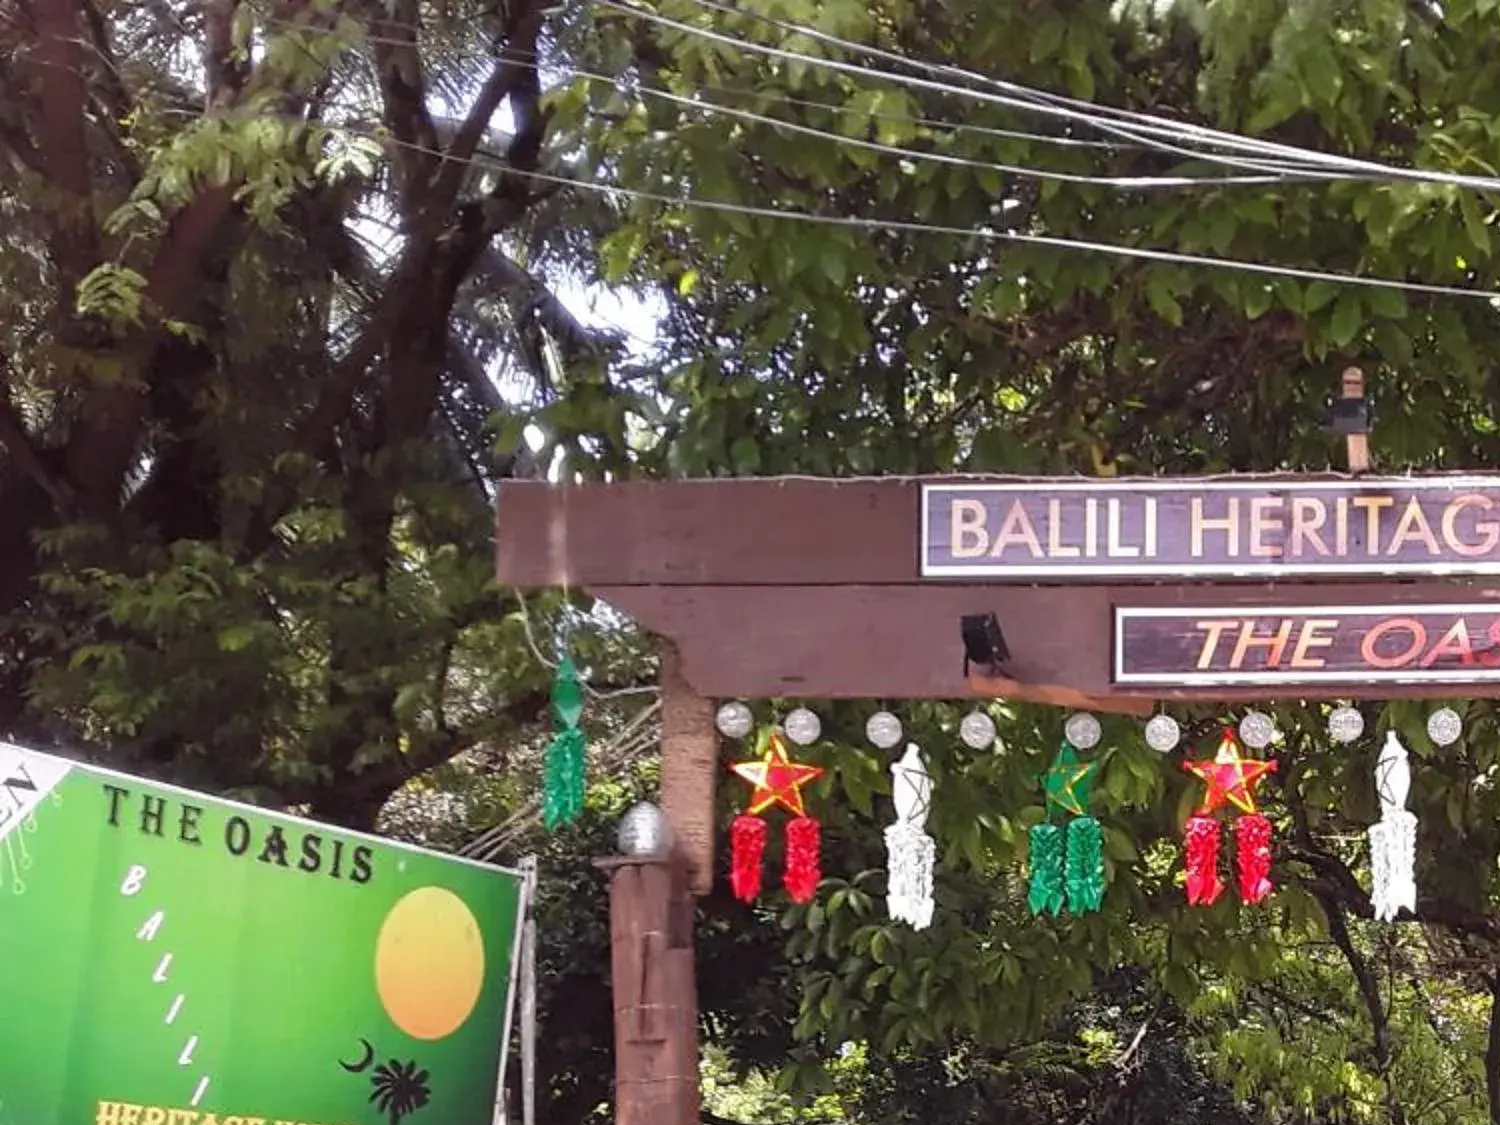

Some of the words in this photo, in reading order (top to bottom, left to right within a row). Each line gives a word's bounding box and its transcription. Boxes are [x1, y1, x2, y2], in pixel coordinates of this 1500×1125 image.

[950, 497, 1157, 558] BALILI
[1196, 618, 1339, 669] THE
[103, 784, 204, 845] THE
[225, 816, 374, 884] OASIS
